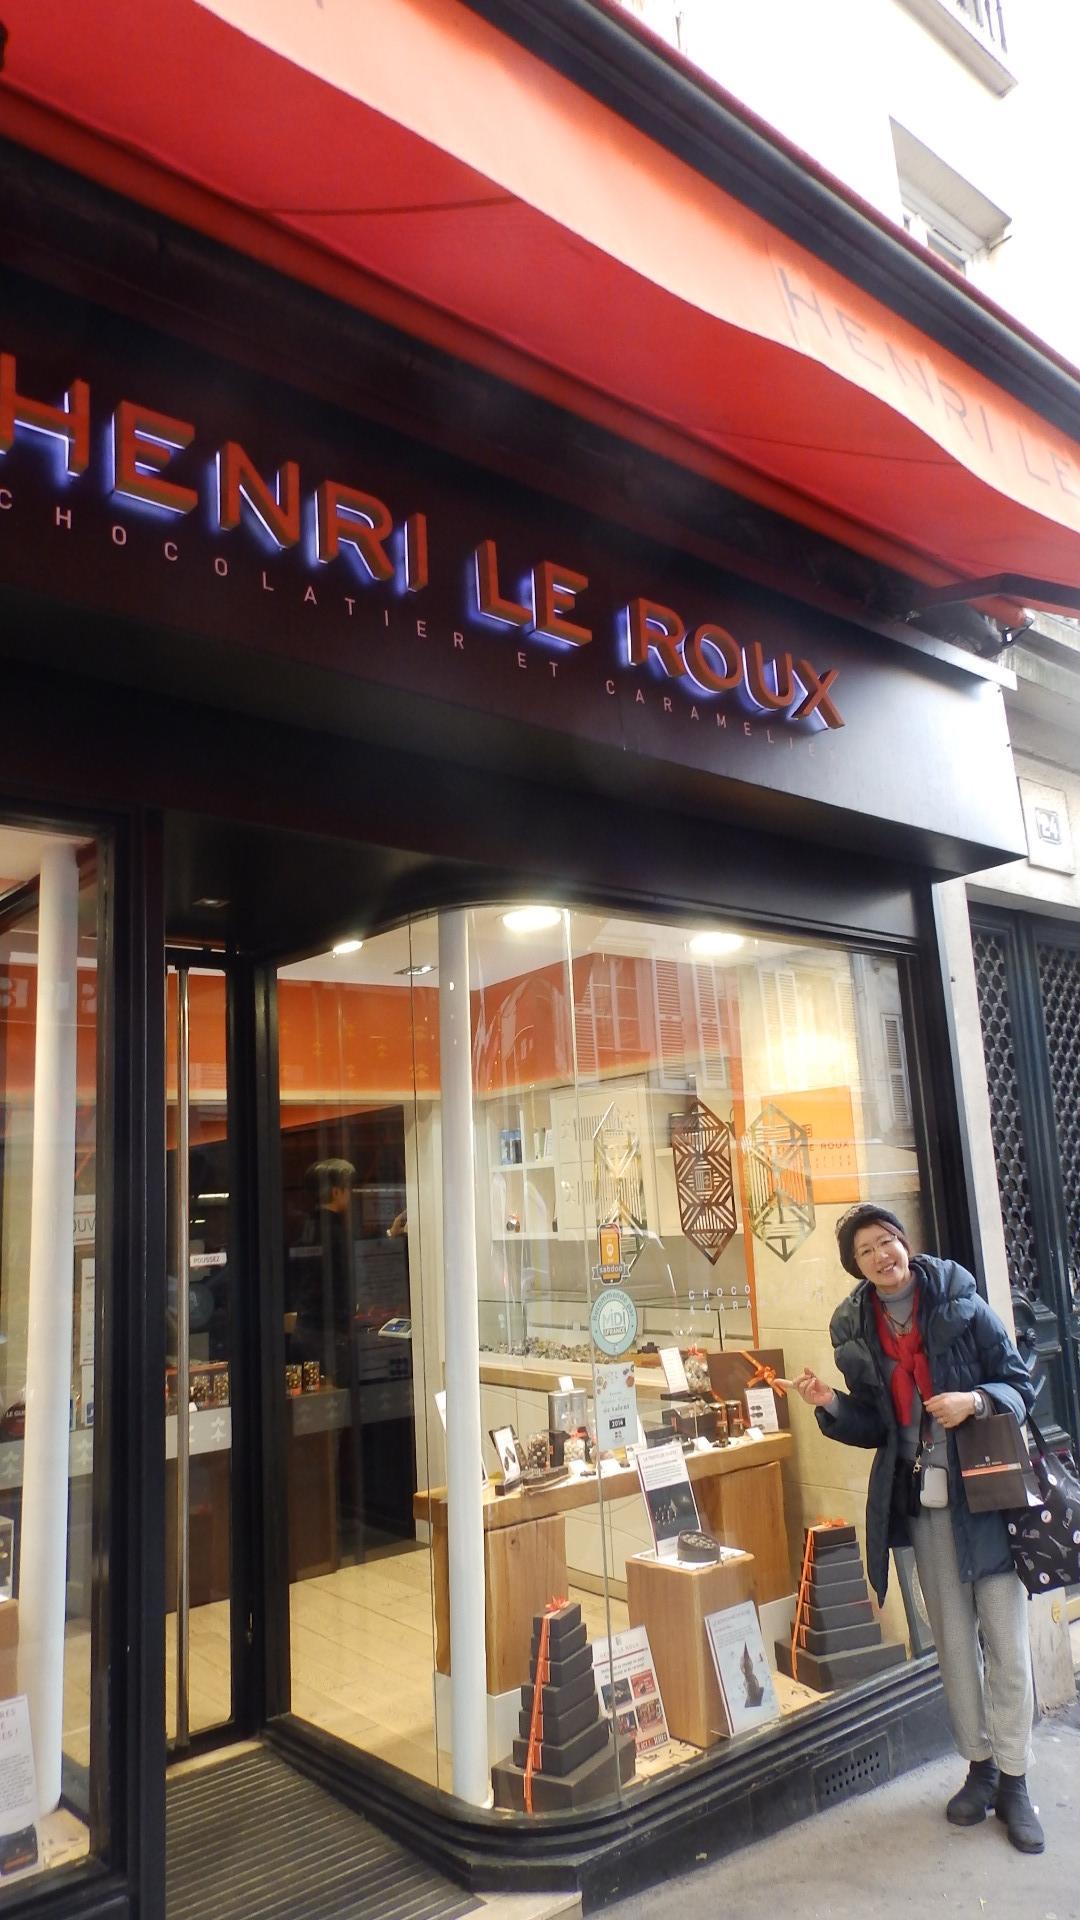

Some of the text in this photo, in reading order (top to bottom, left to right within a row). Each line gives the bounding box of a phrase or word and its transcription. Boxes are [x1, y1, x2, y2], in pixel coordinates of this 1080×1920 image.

[777, 267, 1080, 501] HENRI LE
[0, 352, 846, 730] HENRI LE ROUX
[0, 488, 465, 650] CHOCOLATIER
[517, 651, 561, 679] ET
